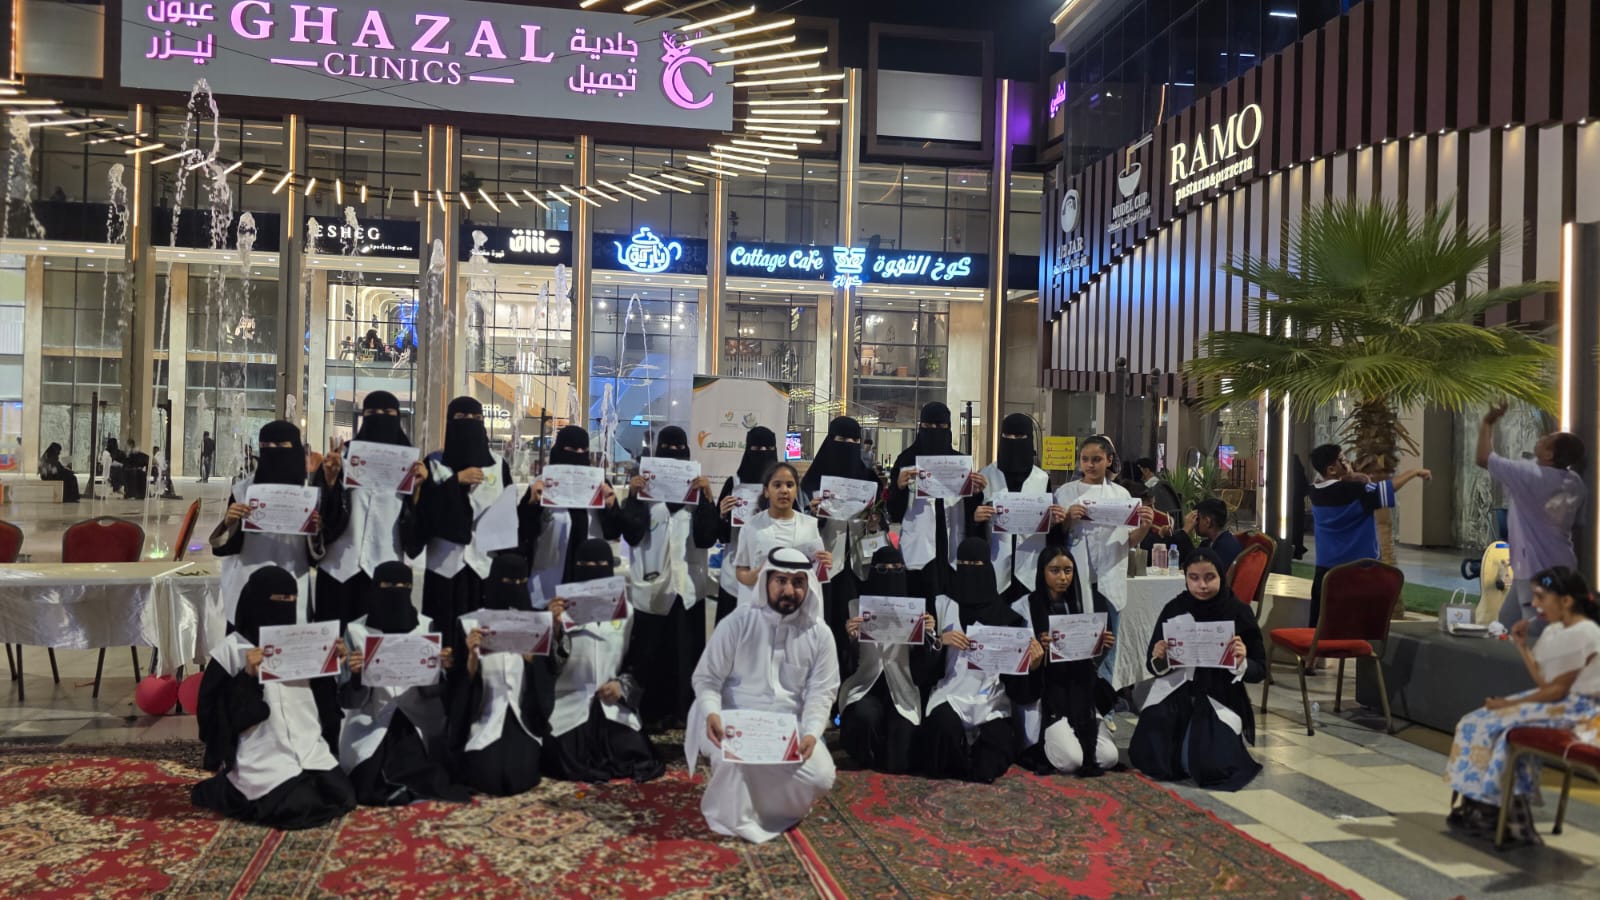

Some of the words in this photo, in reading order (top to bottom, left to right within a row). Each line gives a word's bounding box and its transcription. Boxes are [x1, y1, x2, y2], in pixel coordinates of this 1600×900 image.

[147, 0, 214, 26] عيون
[146, 30, 213, 64] ليزر
[230, 0, 555, 63] GHAZAL
[570, 28, 638, 63] جلدية
[324, 53, 461, 84] CLINICS
[568, 64, 637, 97] تجميل
[1169, 103, 1262, 185] RAMO
[730, 246, 786, 272] Cottage
[788, 249, 824, 272] Cafe
[873, 254, 929, 278] القهوة
[930, 256, 972, 281] كوخ
